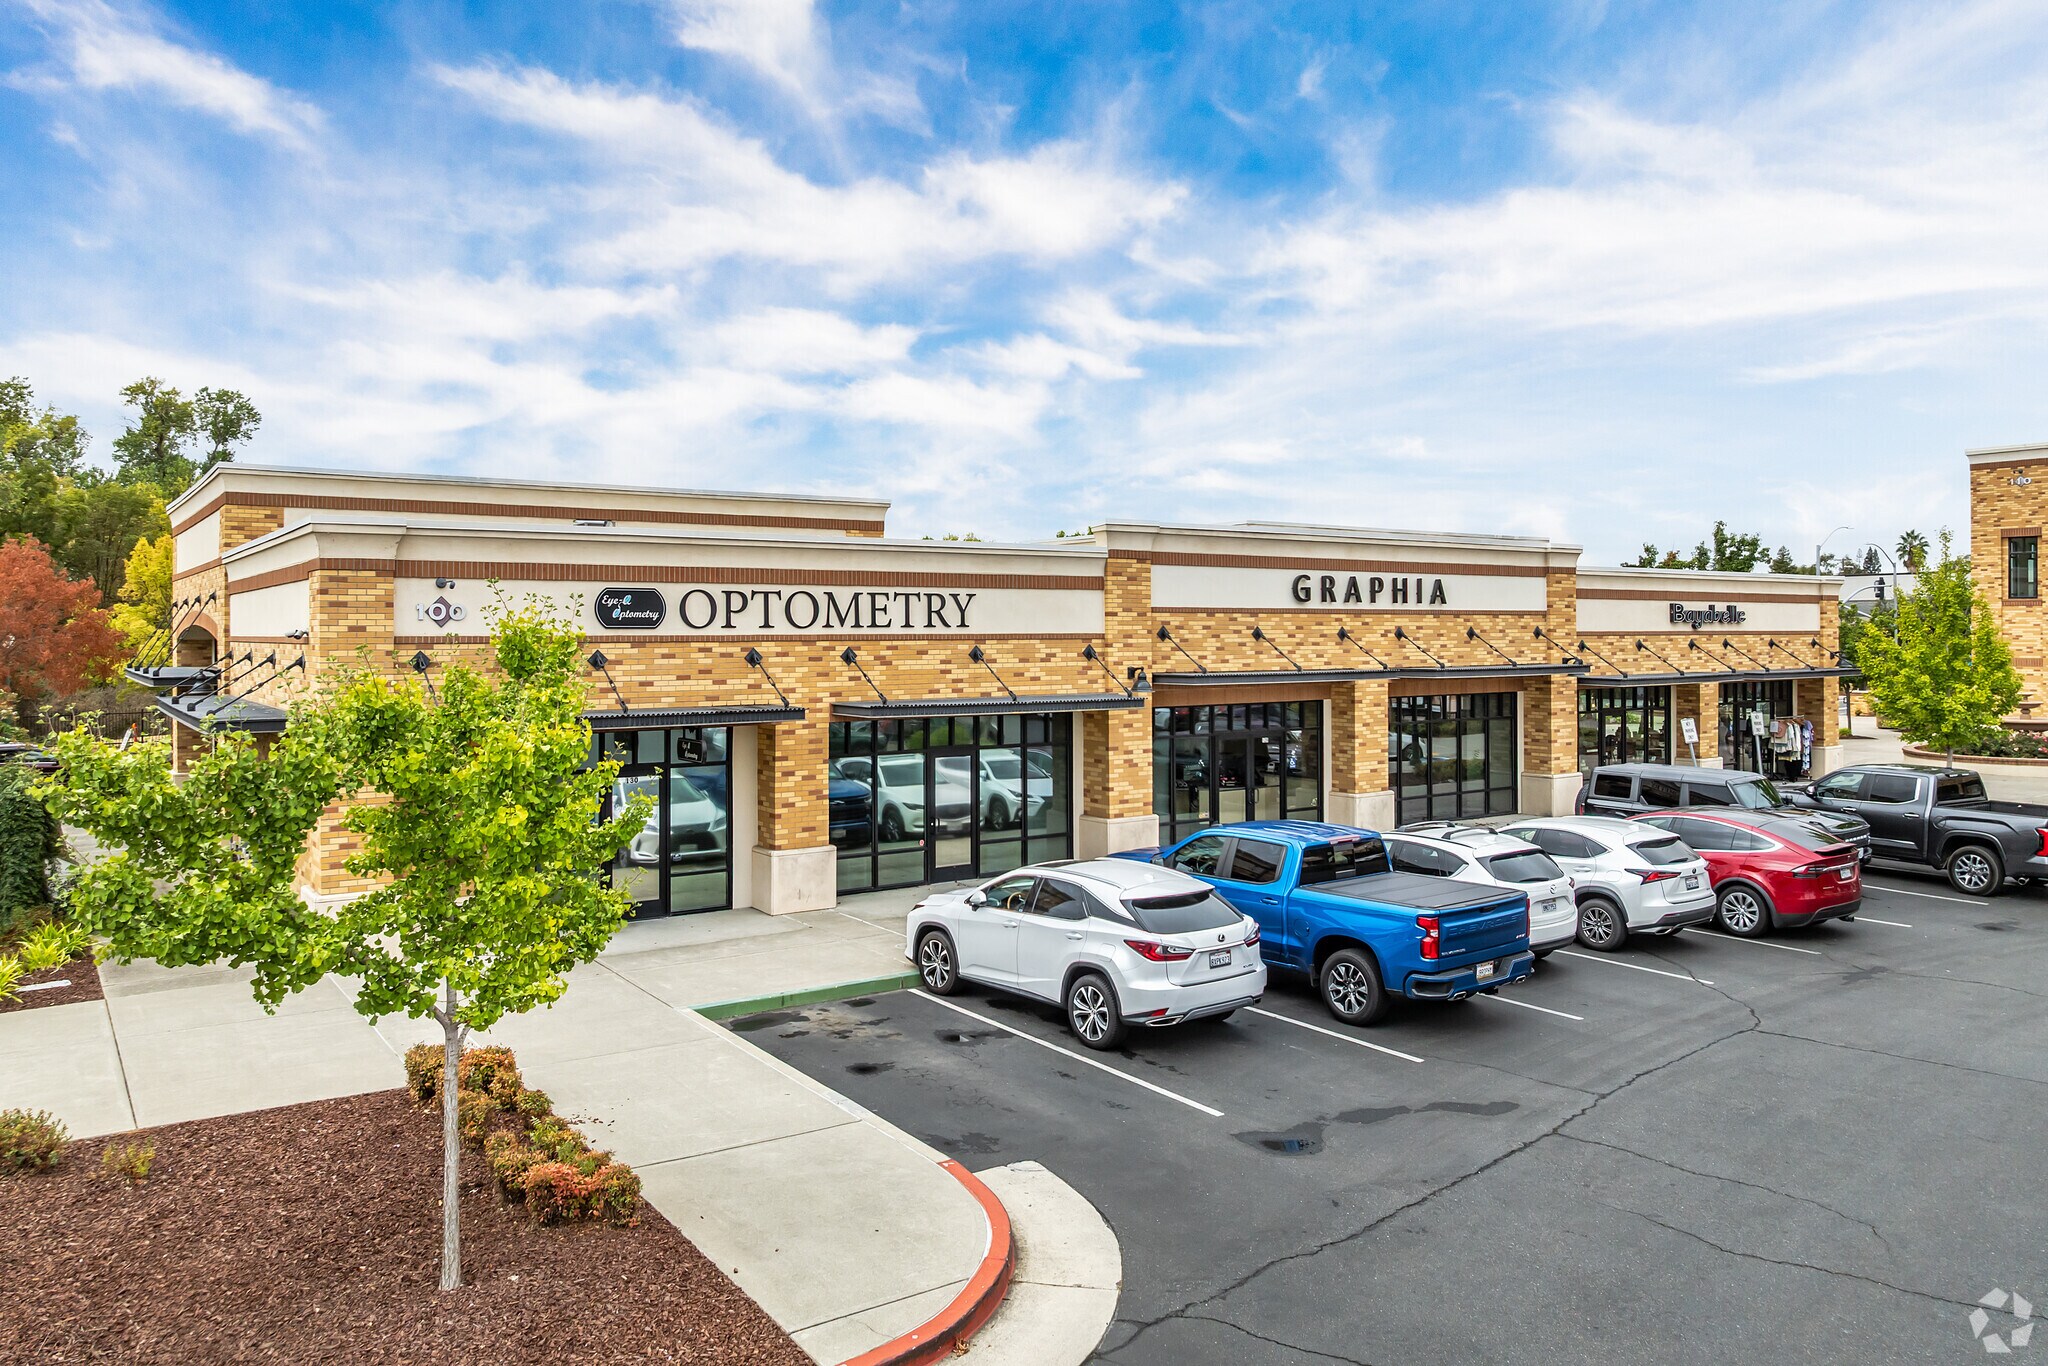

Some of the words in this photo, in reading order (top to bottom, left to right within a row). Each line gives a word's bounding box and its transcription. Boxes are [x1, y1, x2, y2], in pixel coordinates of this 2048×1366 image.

[1292, 574, 1447, 604] GRAPHIA
[416, 603, 466, 621] 100
[612, 608, 659, 621] Optometry
[679, 589, 976, 629] OPTOMETRY
